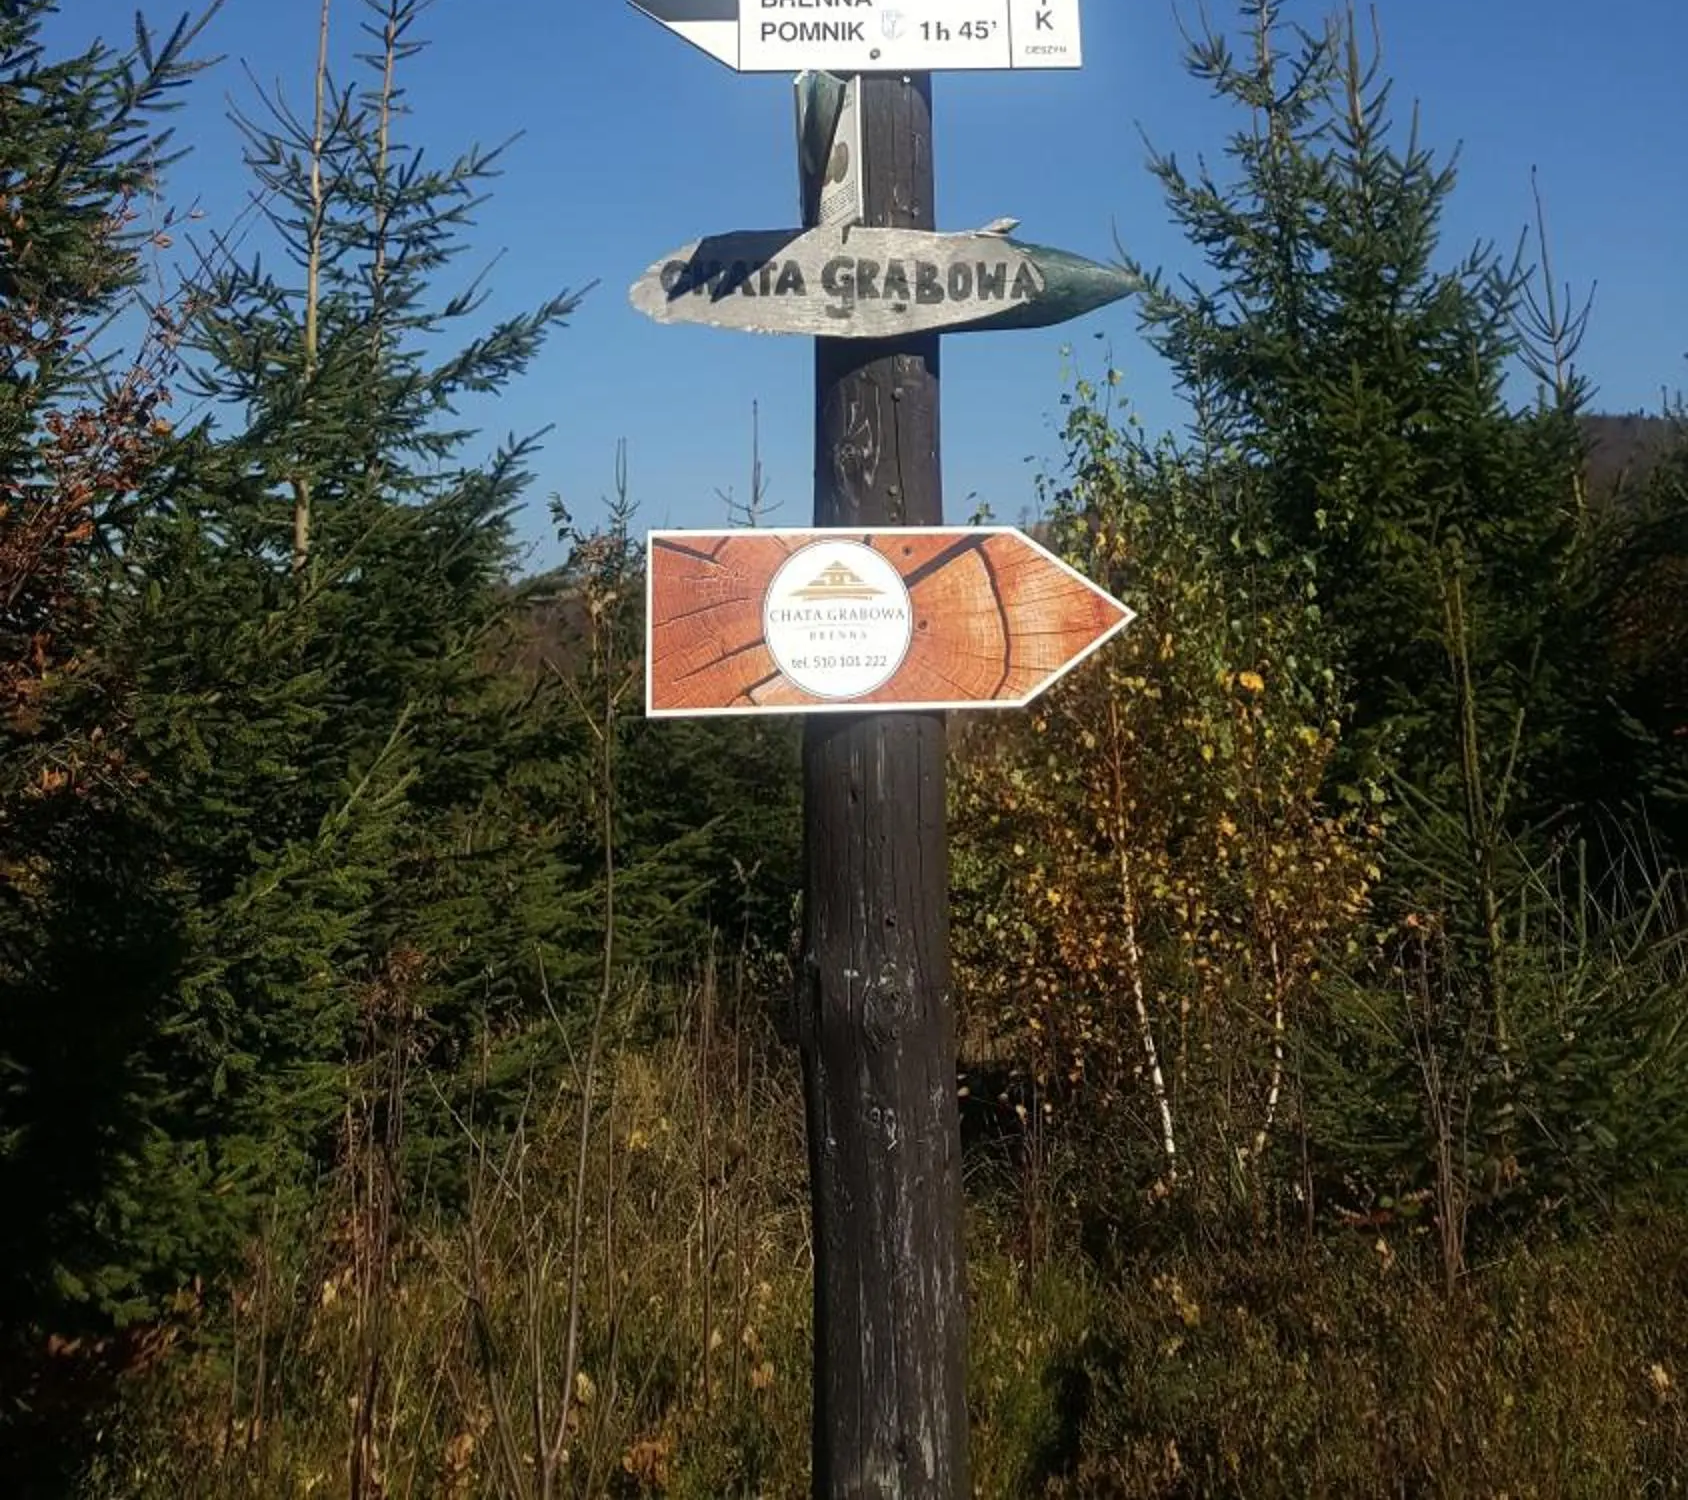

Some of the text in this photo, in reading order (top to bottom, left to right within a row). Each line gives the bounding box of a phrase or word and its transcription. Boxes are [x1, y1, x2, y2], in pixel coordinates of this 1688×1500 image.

[760, 21, 865, 42] POMNIK
[820, 255, 1045, 319] GRABOWA
[769, 606, 905, 622] CHATA GRABOWA
[791, 657, 809, 669] tel.
[813, 655, 837, 668] 510
[864, 655, 887, 667] 222
